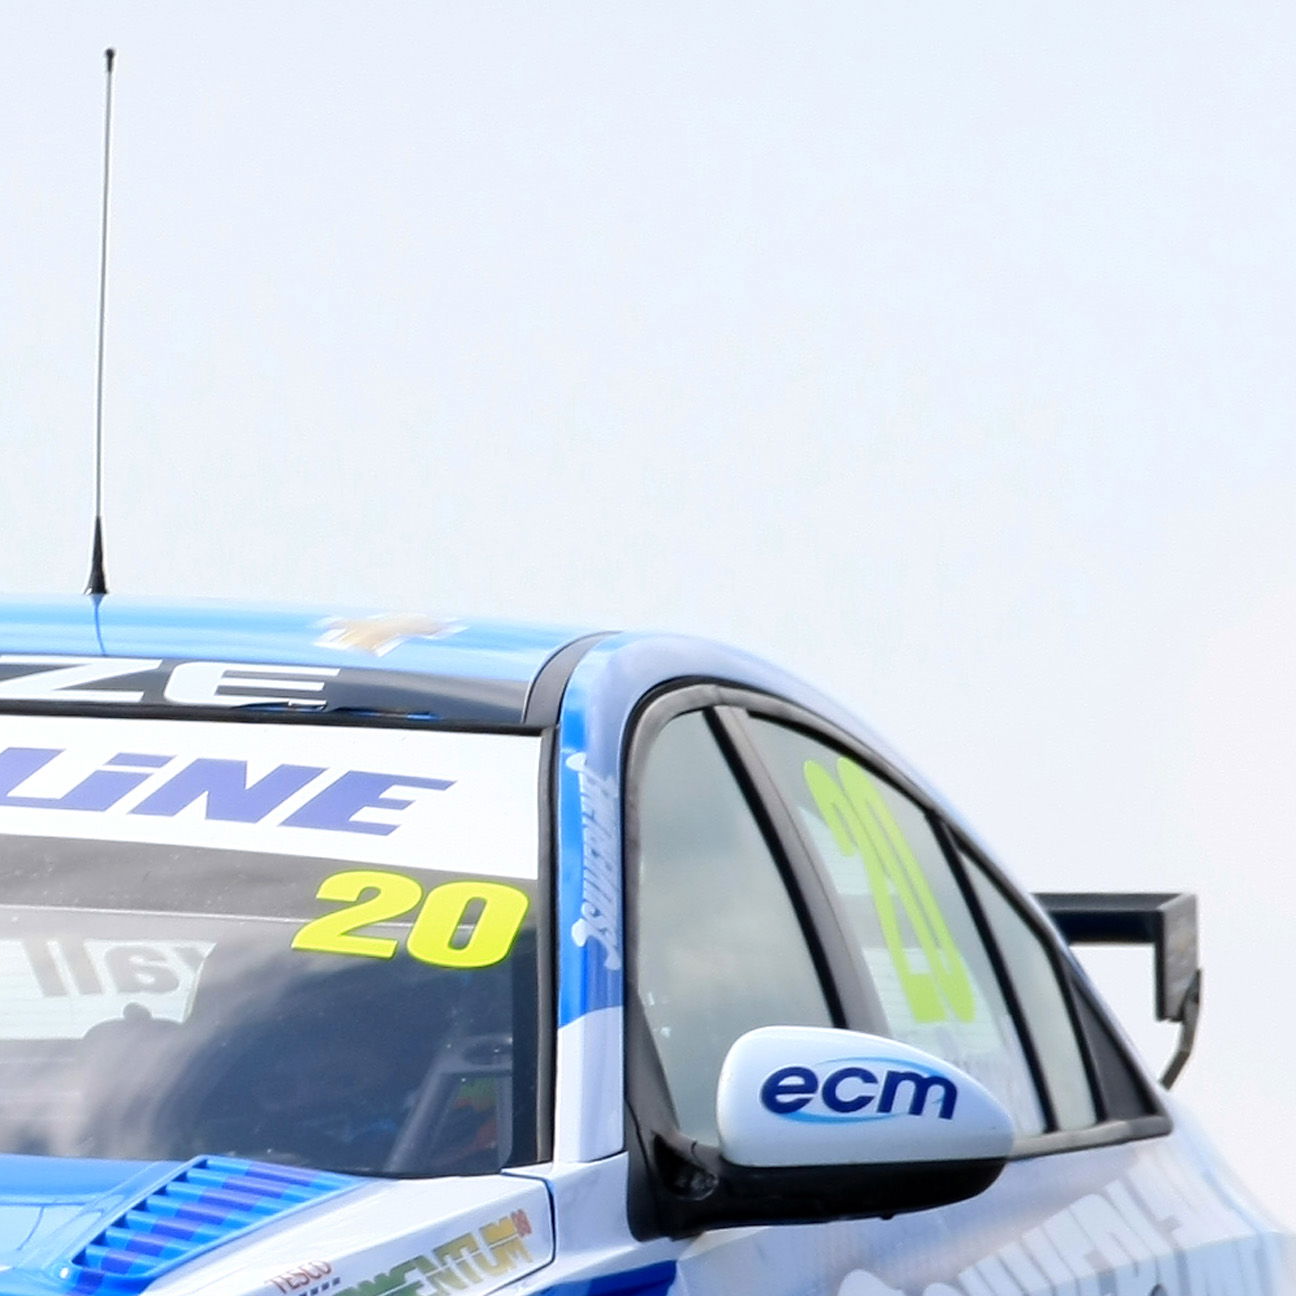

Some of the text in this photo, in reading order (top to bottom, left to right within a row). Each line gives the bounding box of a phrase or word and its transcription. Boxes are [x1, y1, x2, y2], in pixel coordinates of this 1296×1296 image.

[291, 870, 530, 968] 20
[803, 757, 975, 1024] 20
[760, 1065, 958, 1120] ecm
[265, 1260, 333, 1296] TESCO
